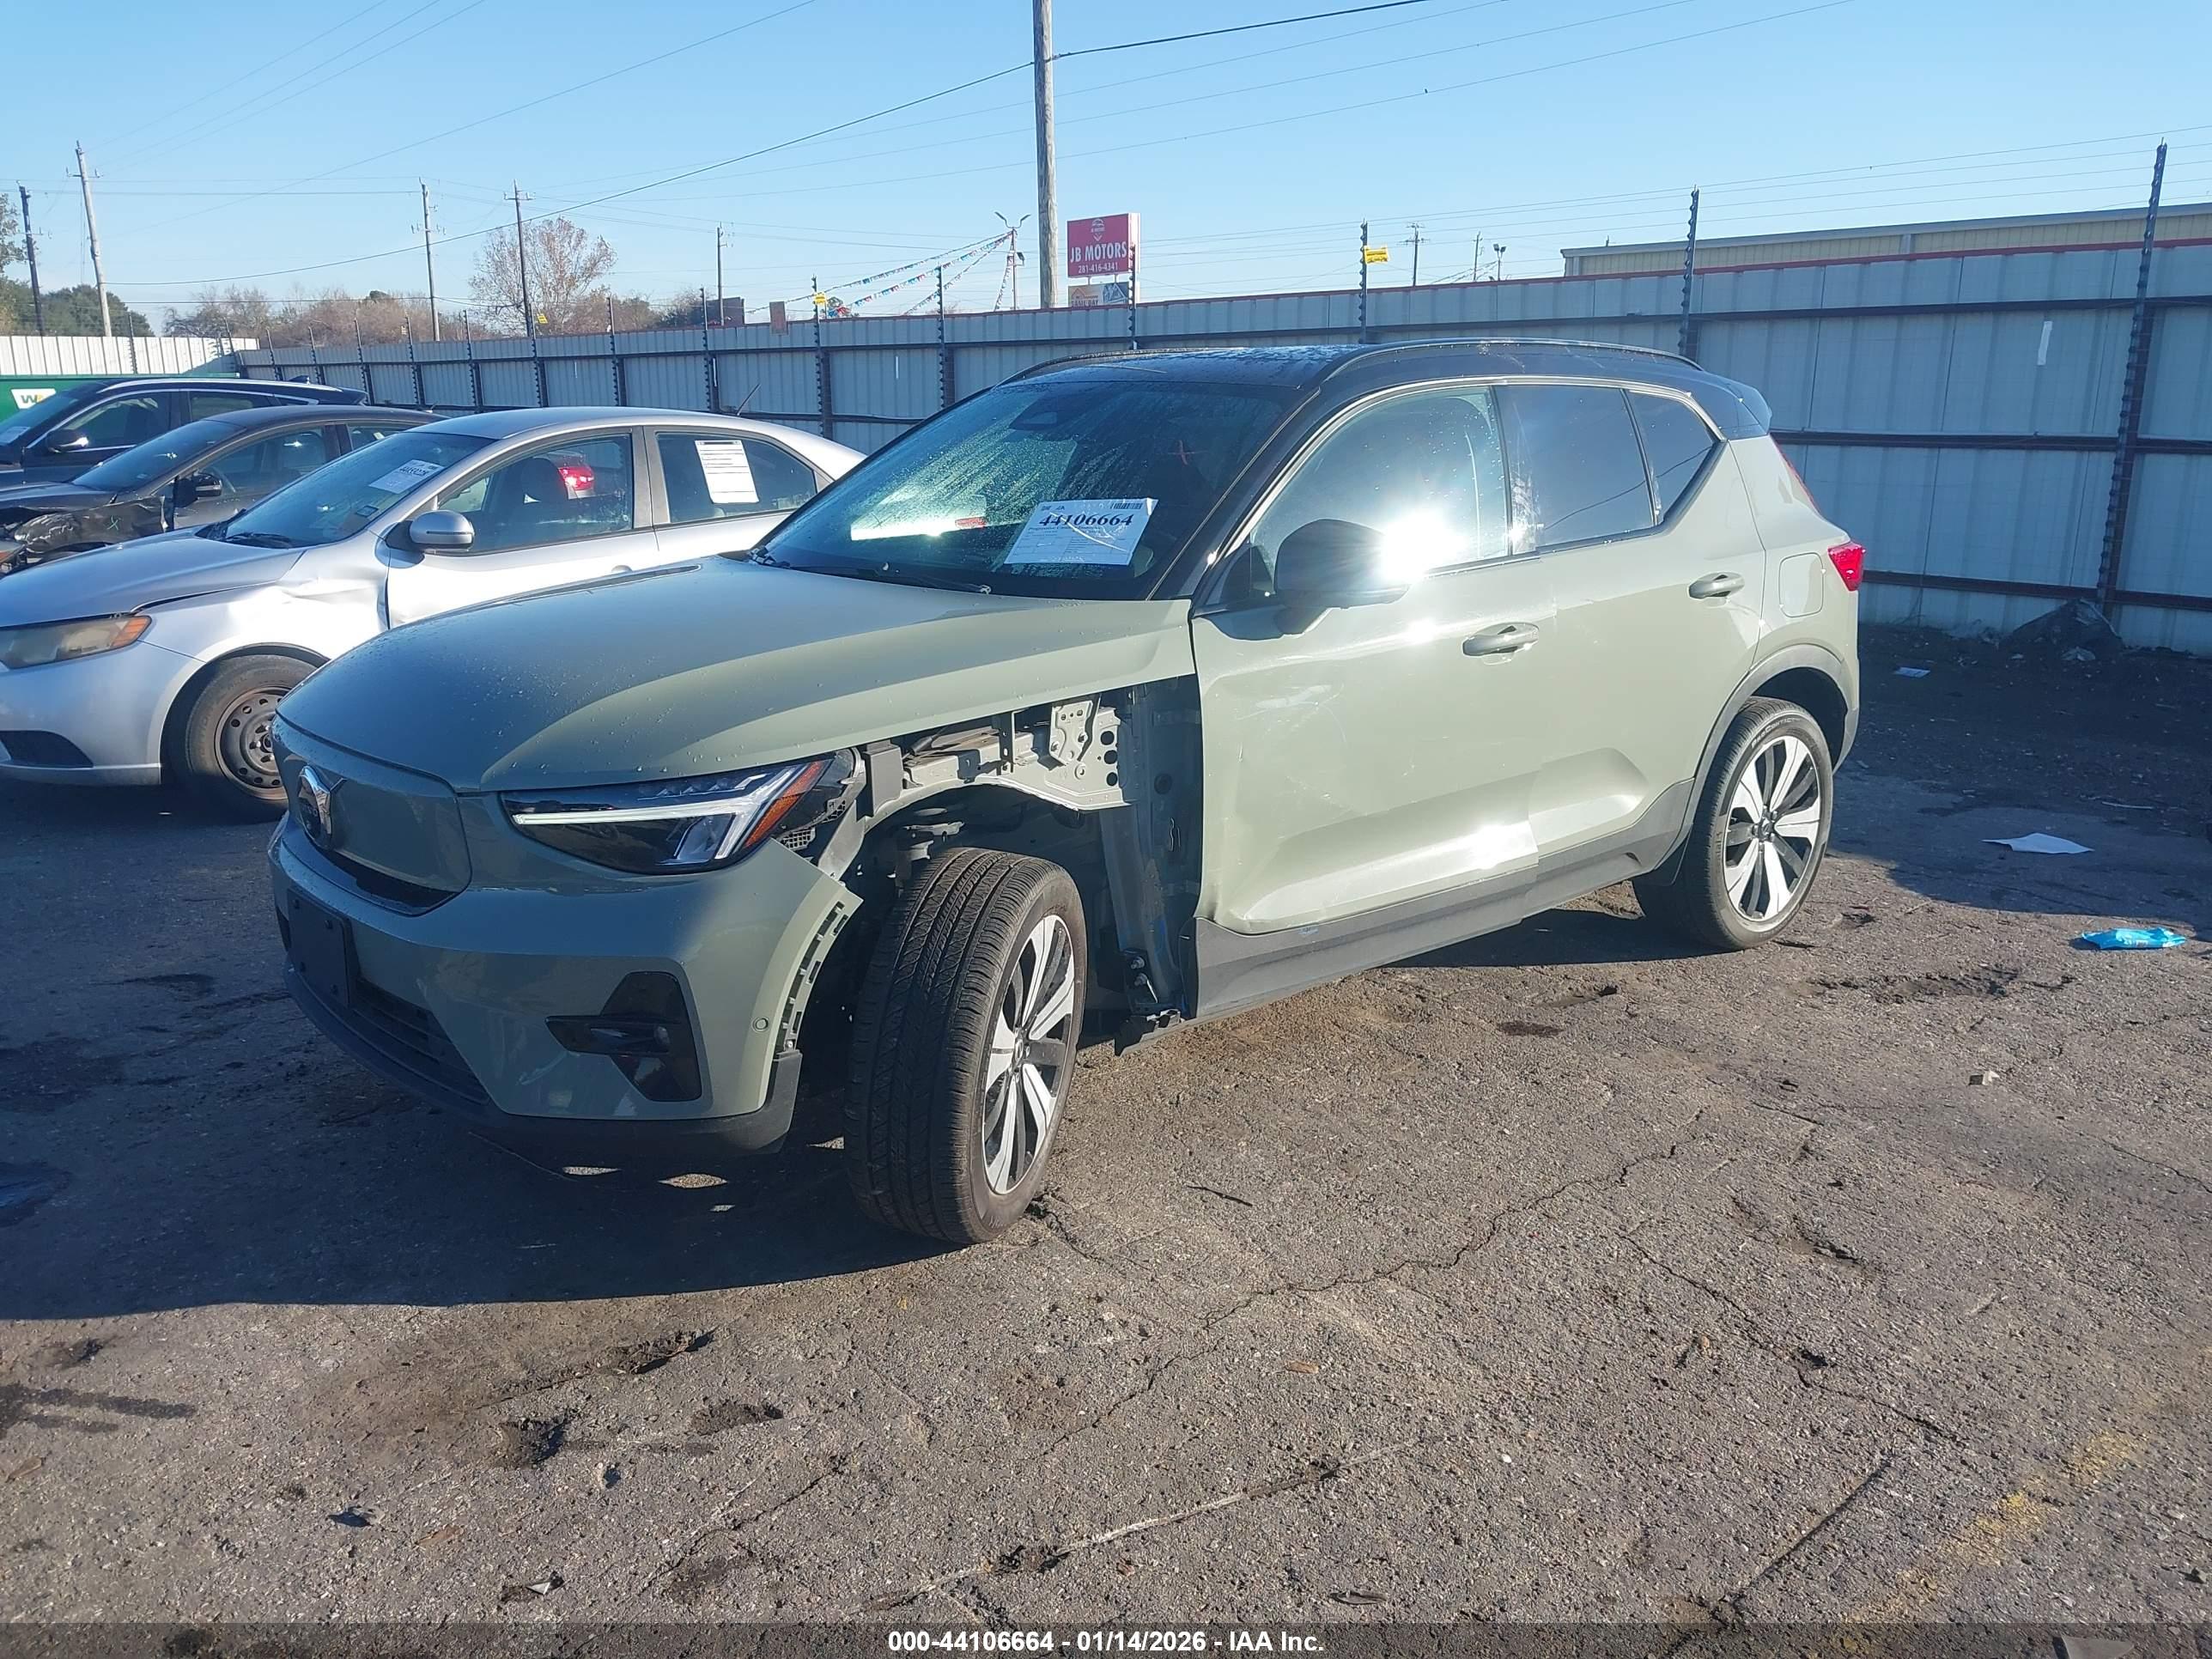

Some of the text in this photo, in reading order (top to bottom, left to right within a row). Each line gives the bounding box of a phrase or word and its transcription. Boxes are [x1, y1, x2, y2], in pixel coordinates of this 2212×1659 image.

[1070, 240, 1127, 263] JB MOTORS
[1039, 514, 1134, 526] 44106664
